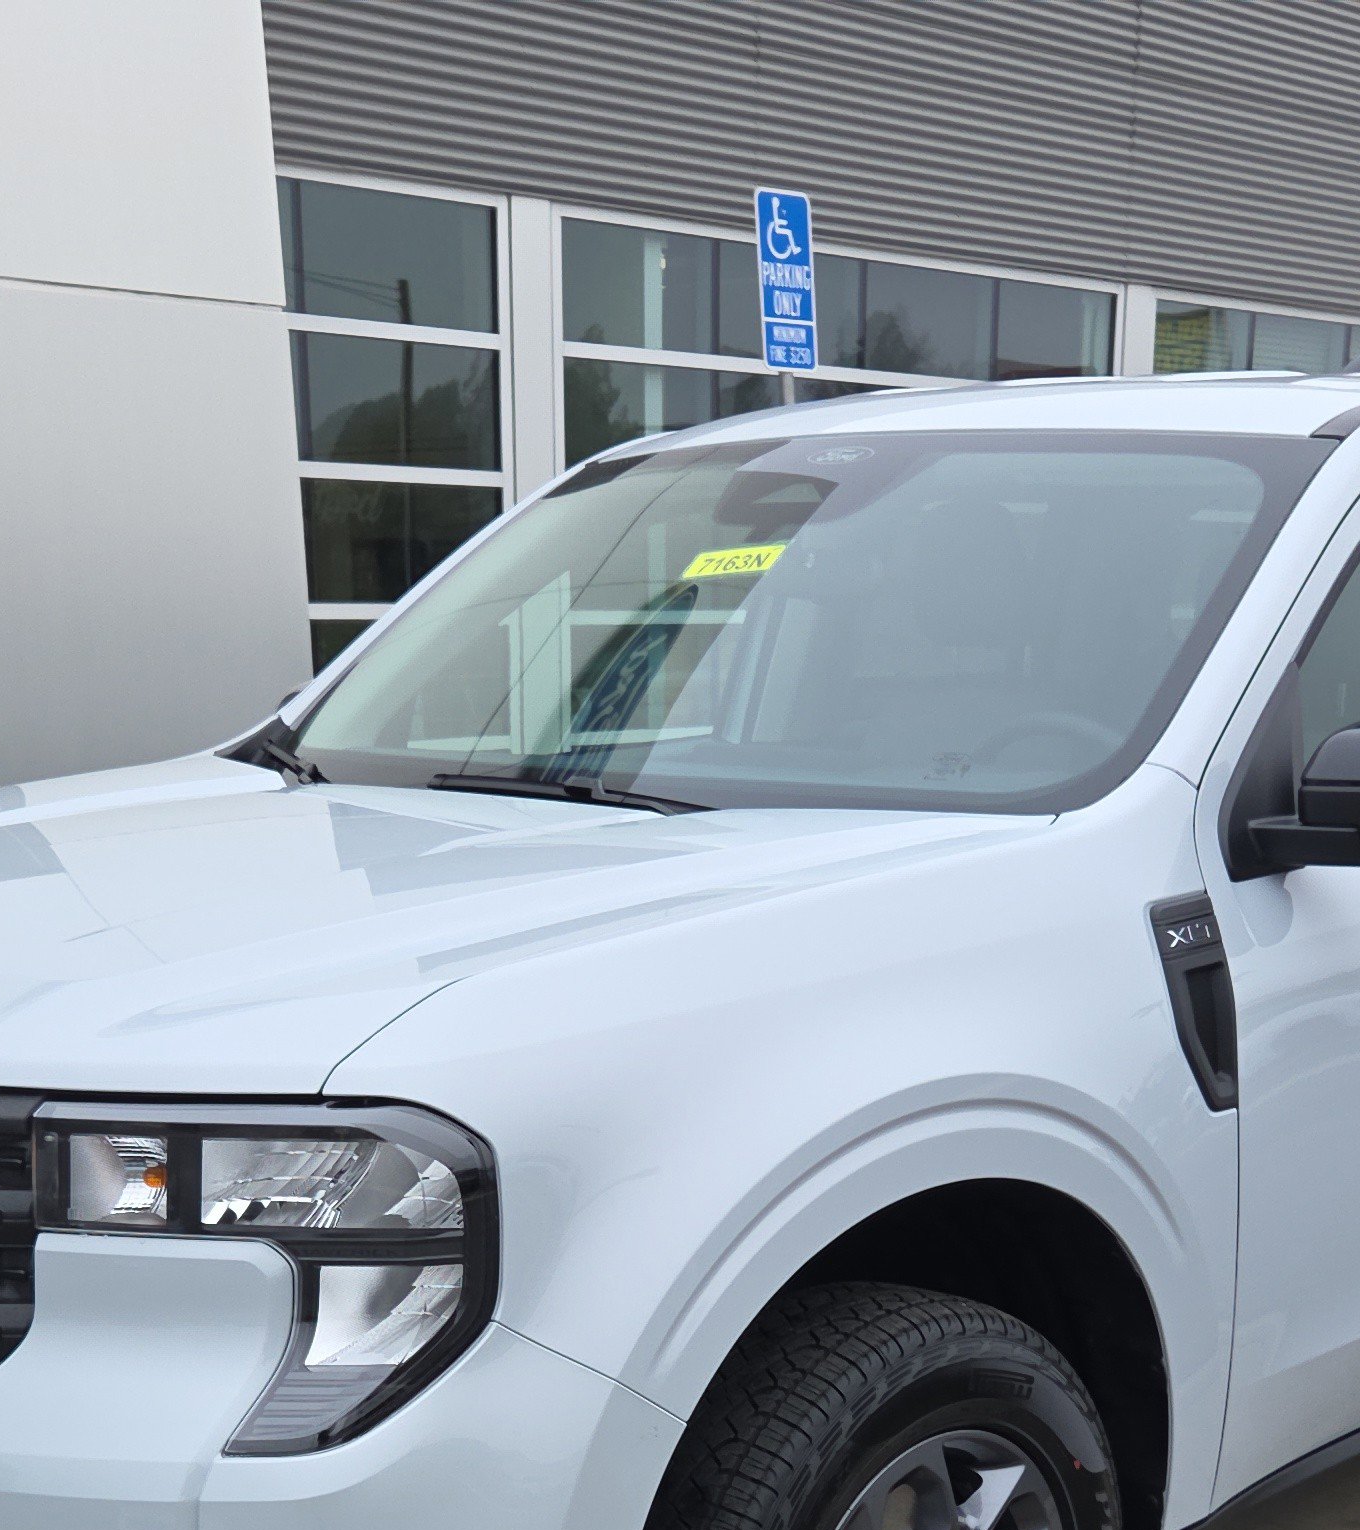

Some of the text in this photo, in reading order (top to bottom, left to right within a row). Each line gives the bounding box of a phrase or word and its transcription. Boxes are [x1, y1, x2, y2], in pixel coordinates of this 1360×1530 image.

[762, 261, 811, 290] PARKING
[773, 290, 802, 317] ONLY
[697, 552, 771, 575] 7163N
